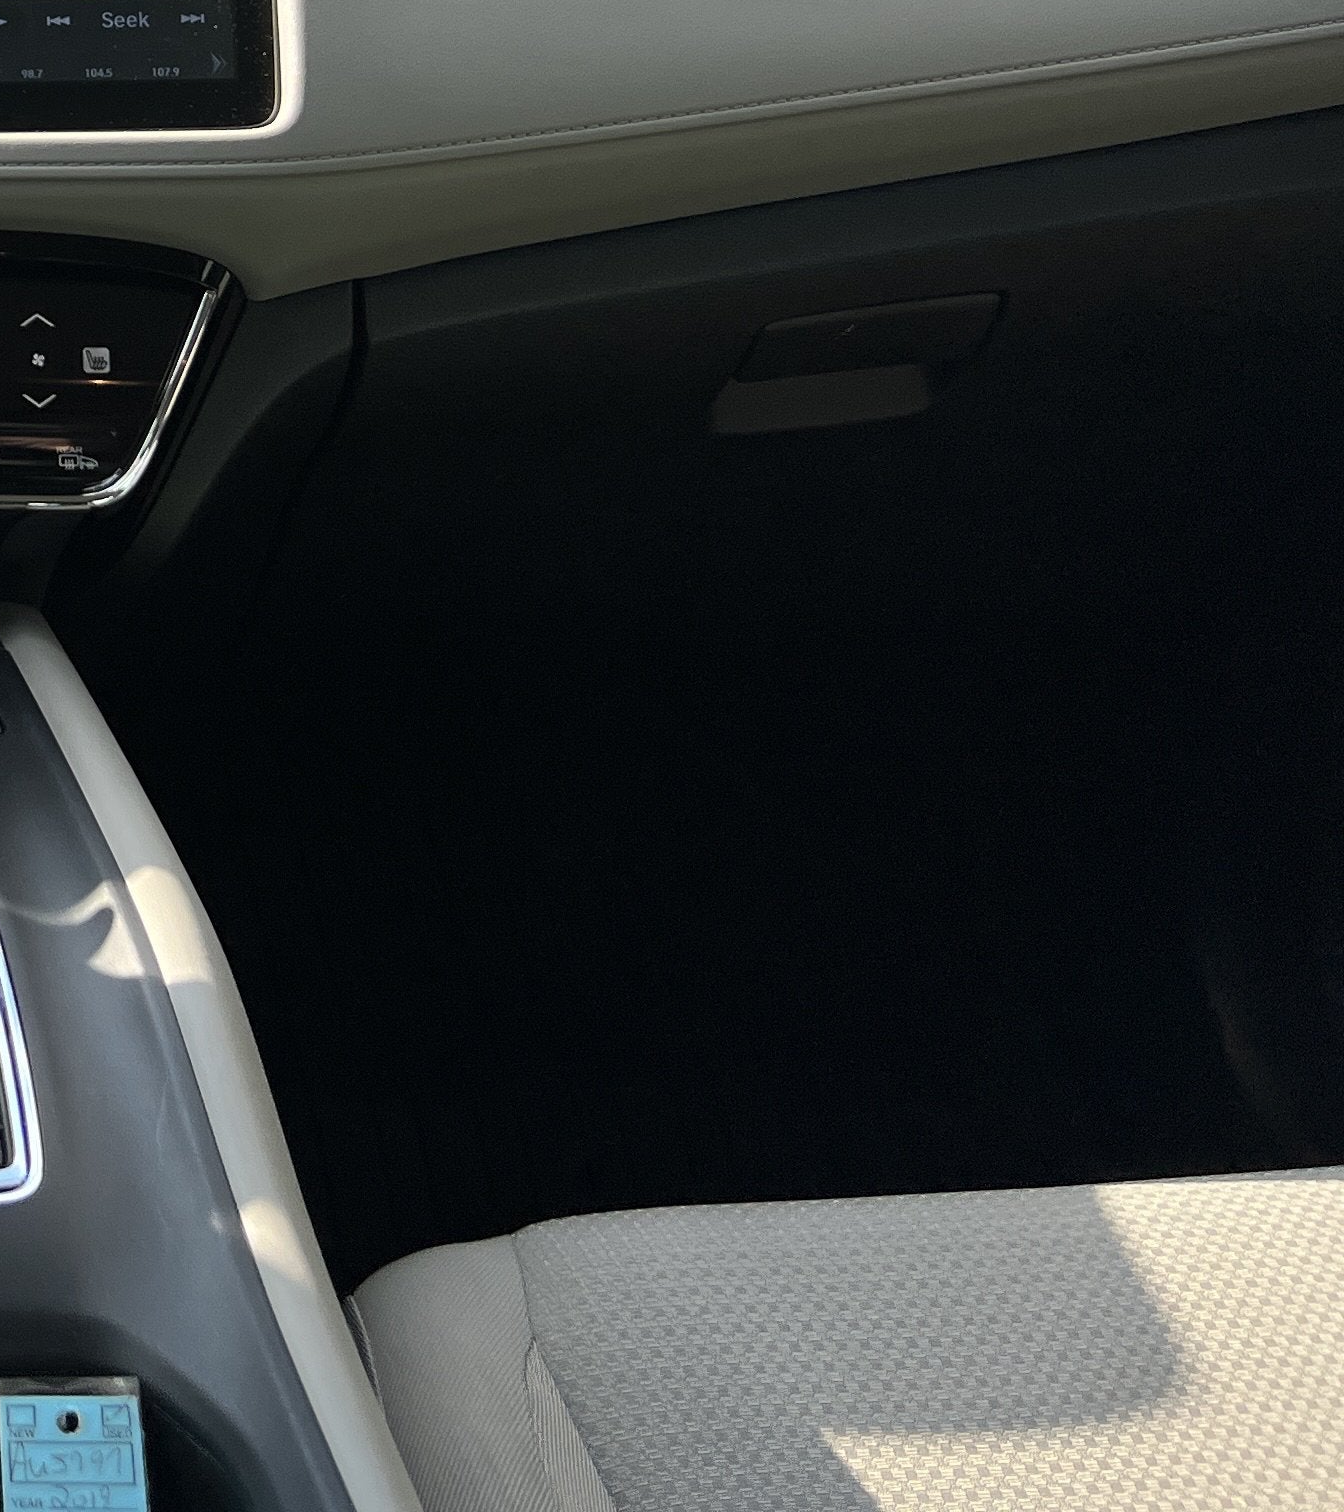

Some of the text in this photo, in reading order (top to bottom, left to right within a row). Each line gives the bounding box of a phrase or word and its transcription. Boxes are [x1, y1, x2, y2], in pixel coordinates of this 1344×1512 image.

[101, 11, 150, 28] Seek
[20, 69, 43, 79] 98.7
[85, 67, 112, 78] 104.5
[152, 67, 180, 77] 107.9
[56, 445, 83, 454] REAR
